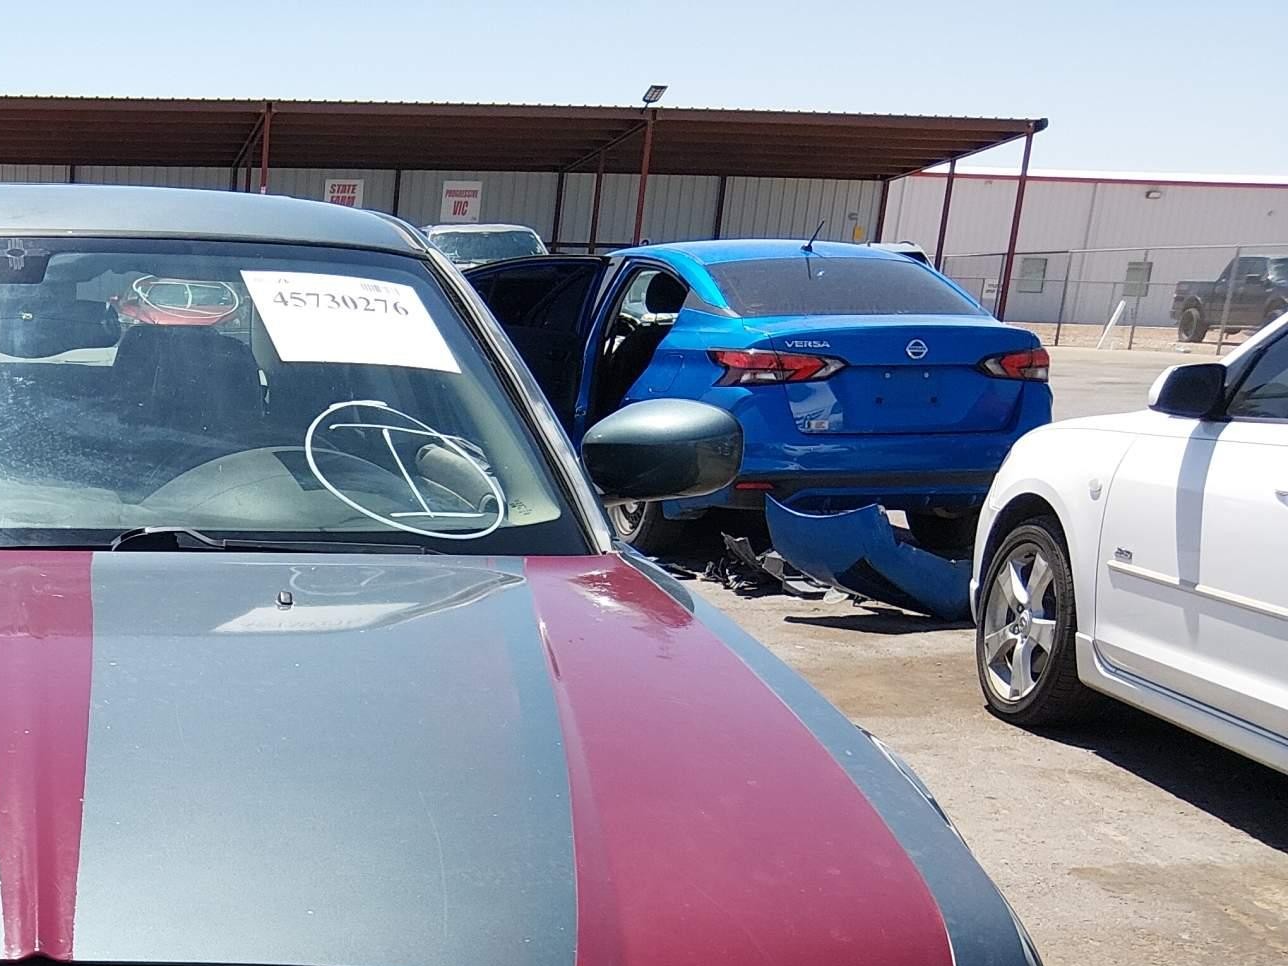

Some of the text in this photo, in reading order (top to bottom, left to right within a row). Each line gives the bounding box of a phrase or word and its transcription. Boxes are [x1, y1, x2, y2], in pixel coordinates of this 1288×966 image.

[329, 183, 358, 194] STATE
[452, 200, 469, 216] VIC
[272, 290, 410, 317] 45730276
[784, 340, 831, 348] VERSA
